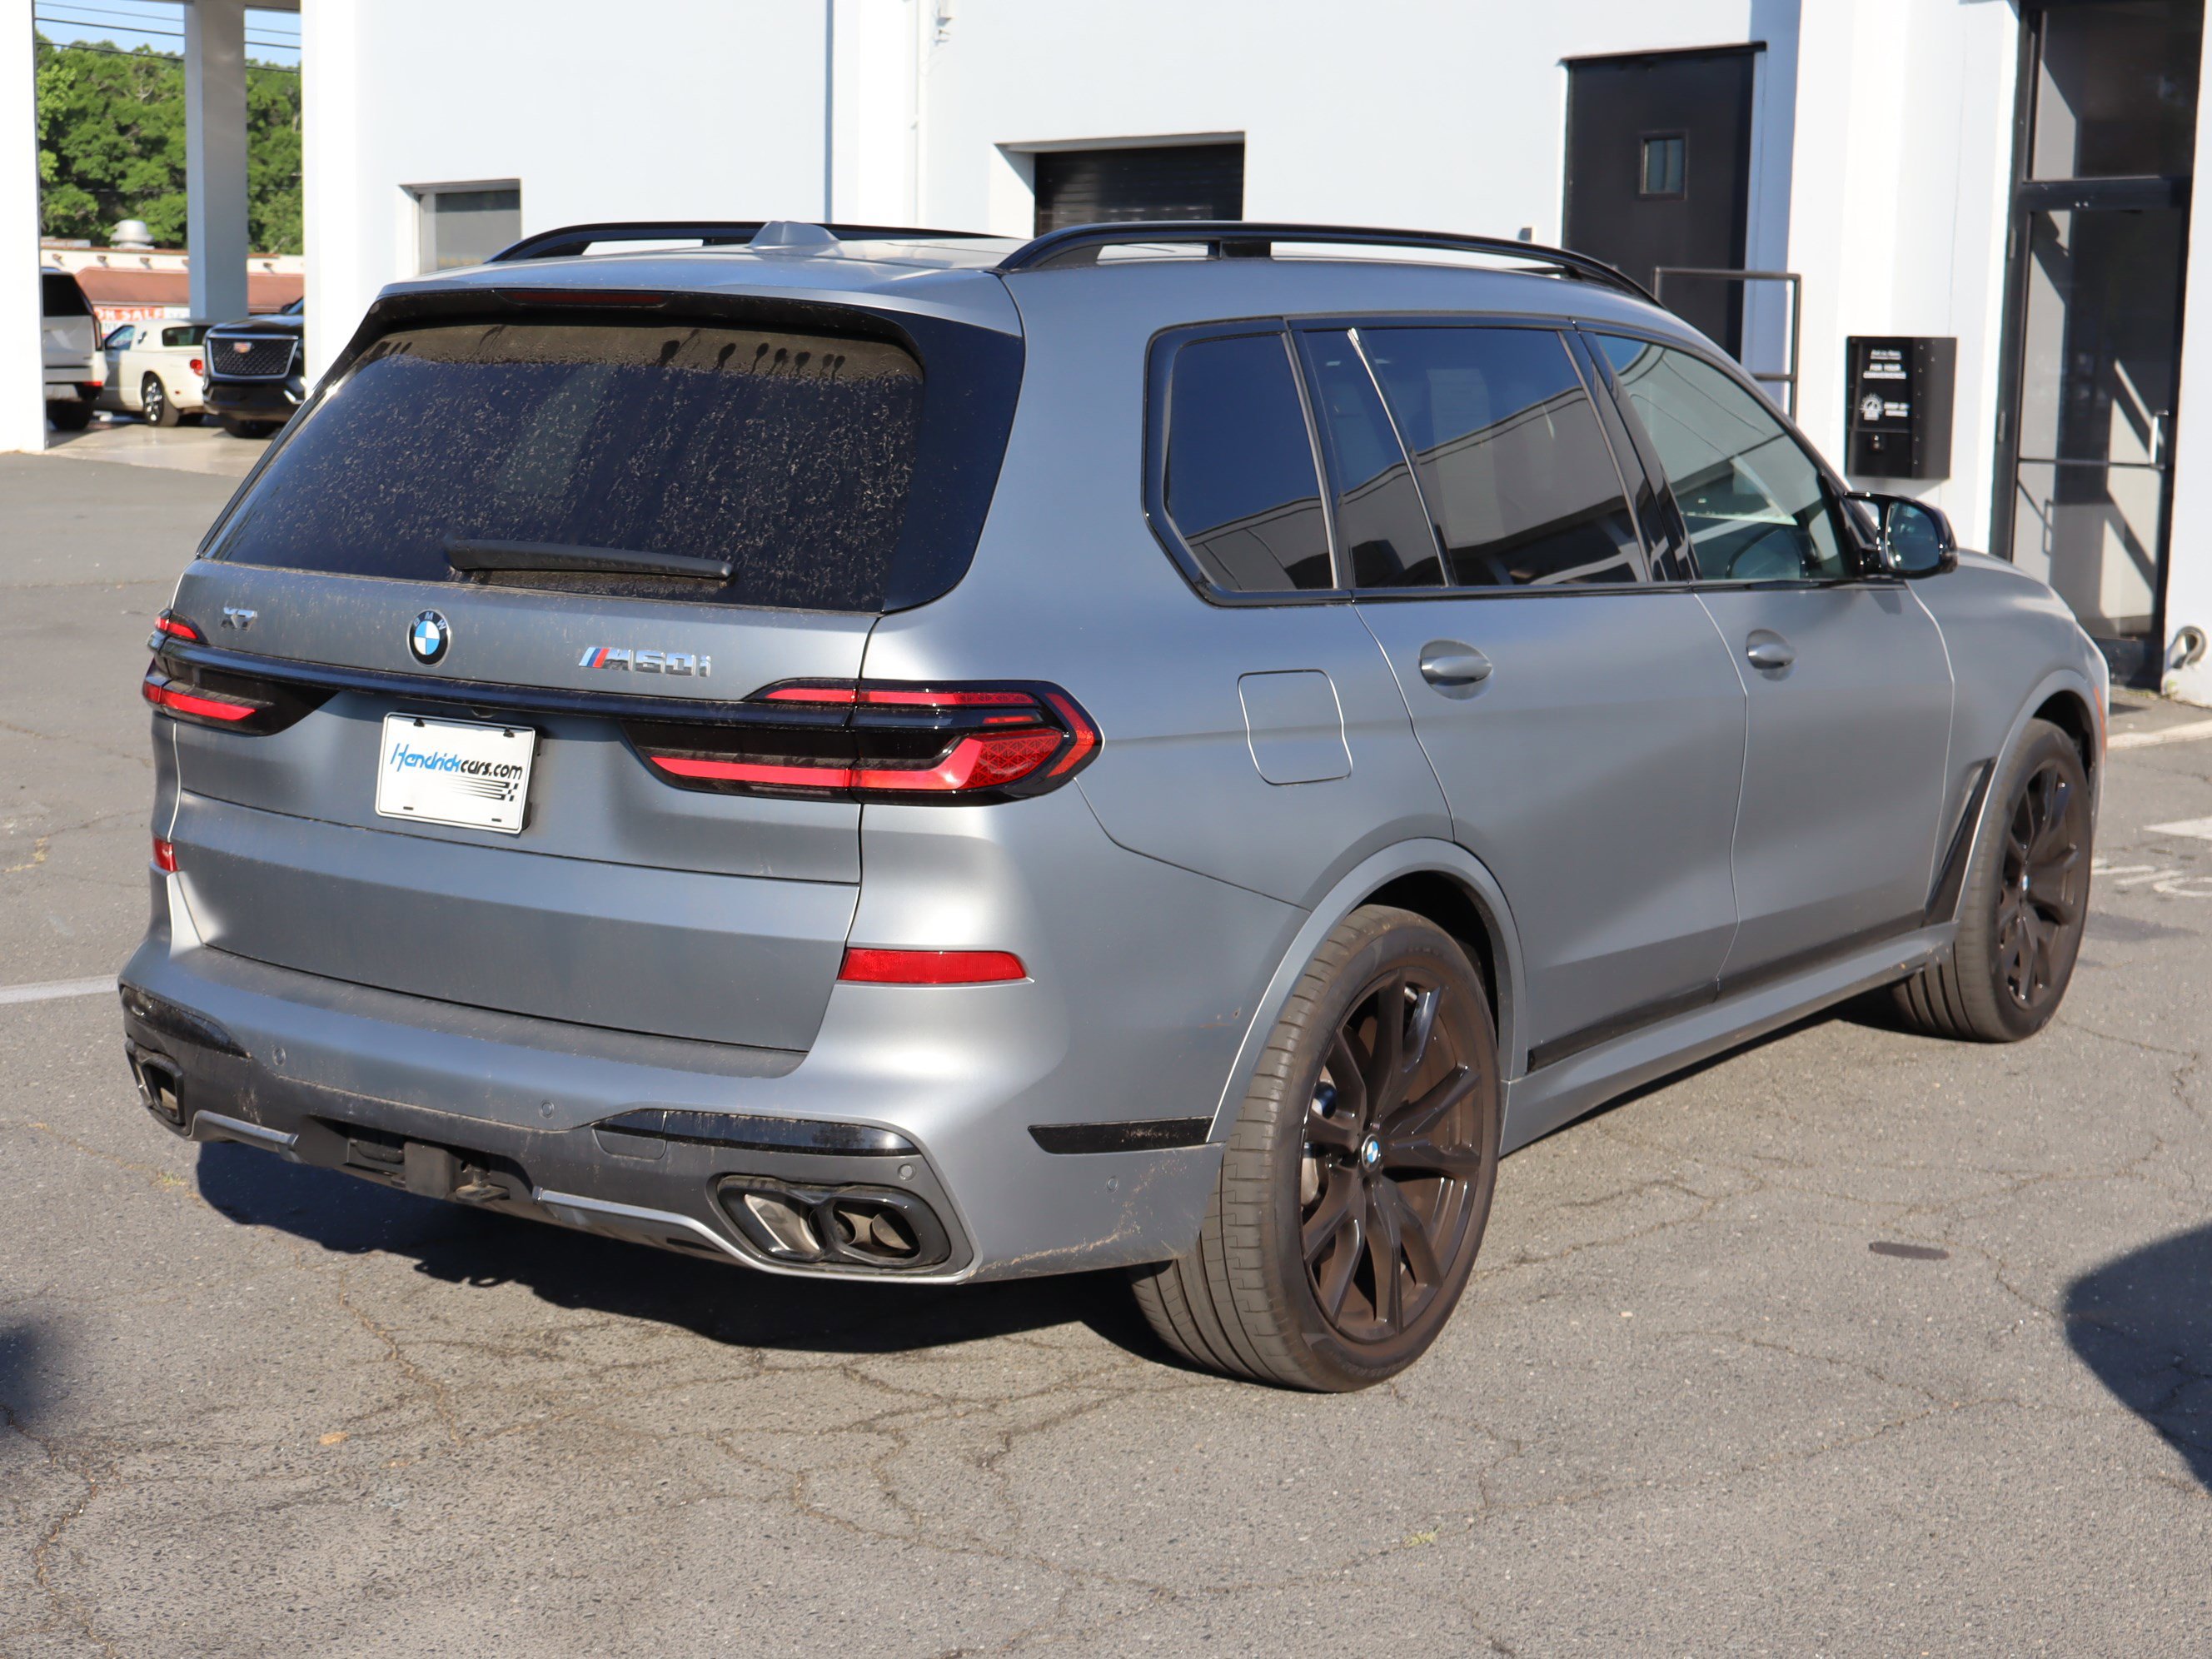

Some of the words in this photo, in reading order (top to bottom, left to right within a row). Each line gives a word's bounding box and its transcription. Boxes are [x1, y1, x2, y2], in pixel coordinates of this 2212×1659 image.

[120, 307, 164, 321] SALE
[220, 606, 258, 632] X7
[580, 646, 712, 678] M60i
[390, 742, 523, 780] Hendrickcars.com
